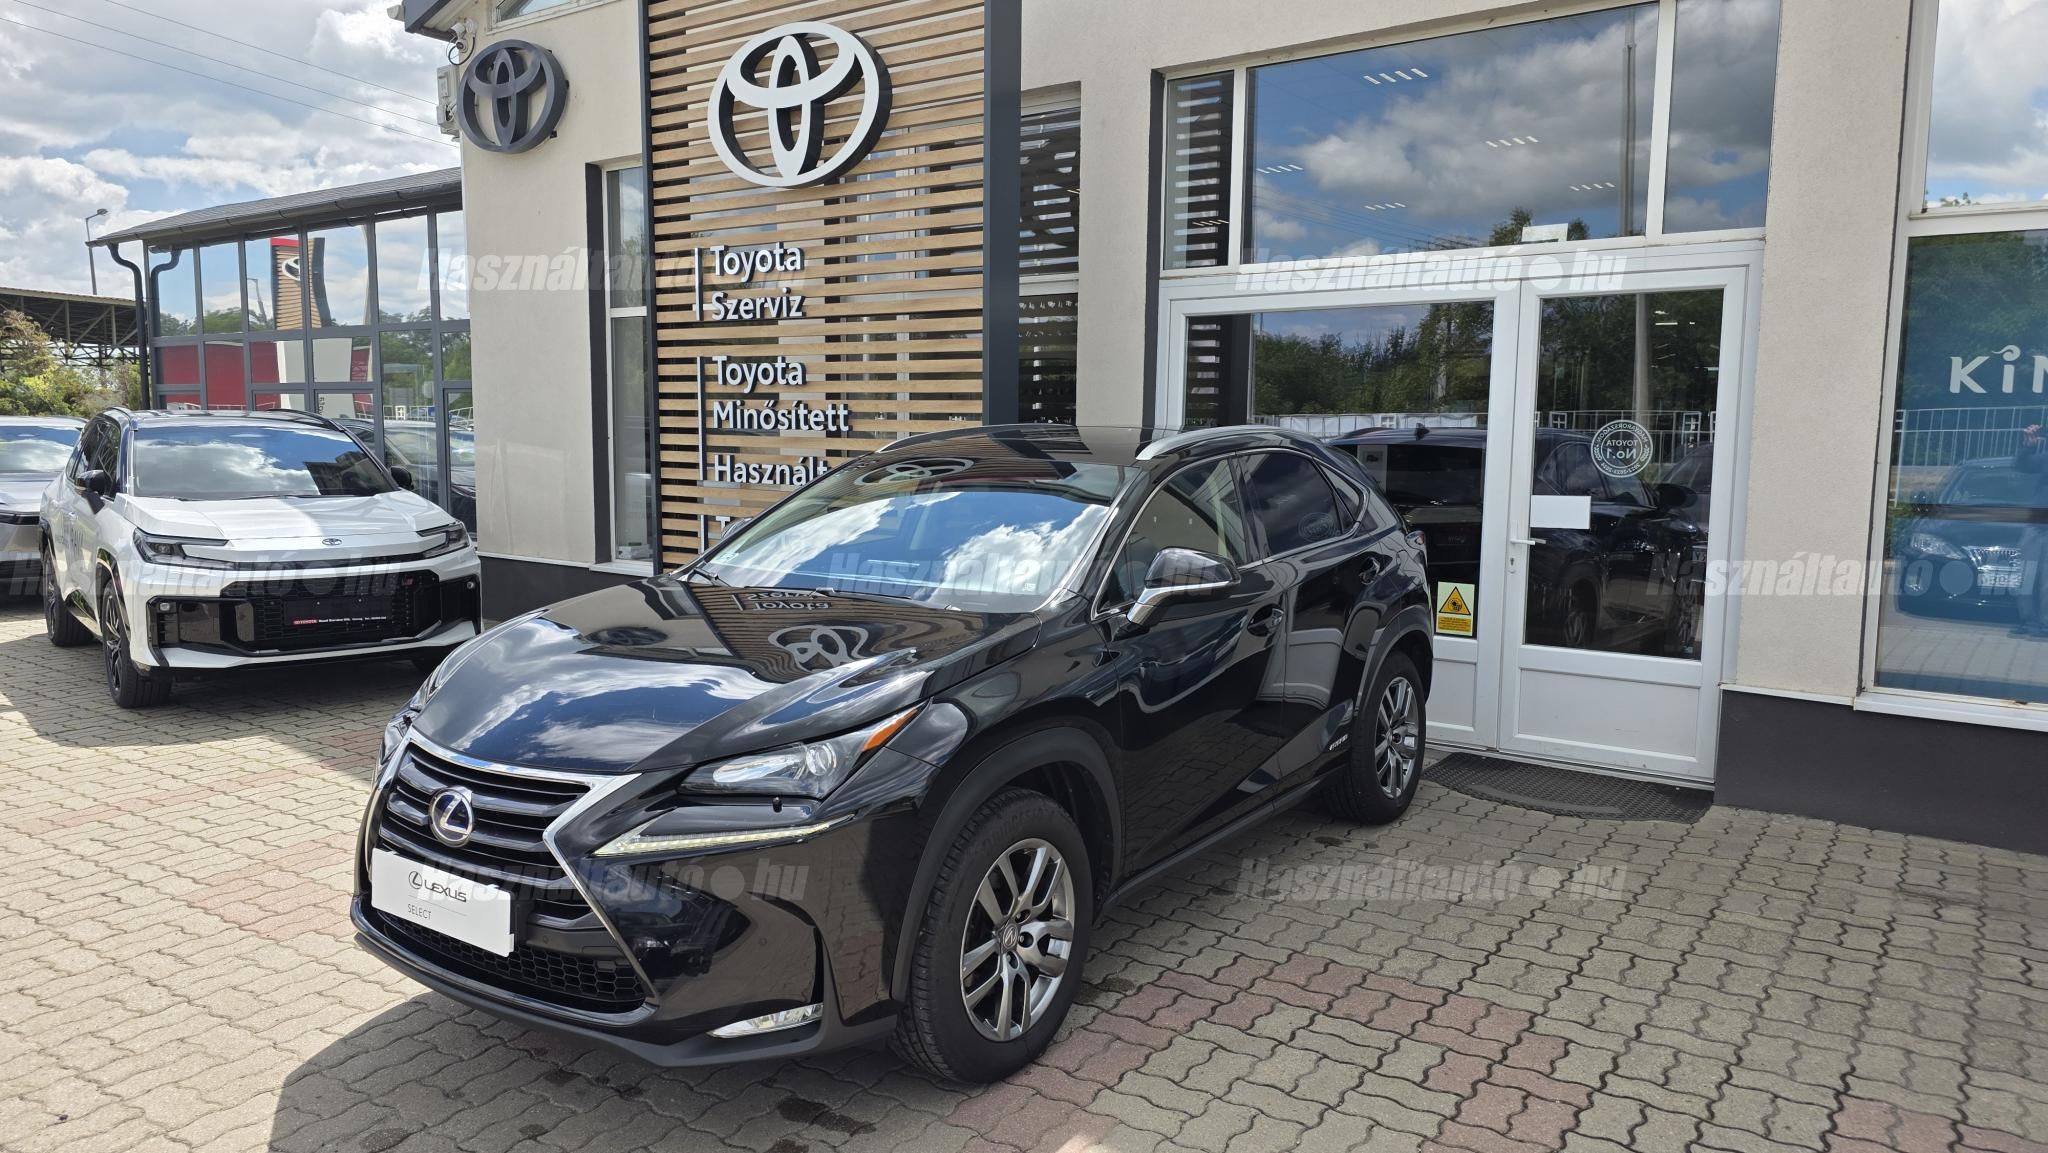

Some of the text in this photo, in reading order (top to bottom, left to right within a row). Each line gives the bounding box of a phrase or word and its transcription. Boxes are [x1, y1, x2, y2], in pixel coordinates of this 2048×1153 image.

[710, 242, 802, 283] Toyota
[711, 288, 803, 320] Szerviz
[712, 355, 804, 394] Toyota
[713, 401, 849, 432] Minősített
[714, 454, 828, 486] Használt
[424, 879, 467, 903] LEXUS
[407, 903, 432, 920] SELECT
